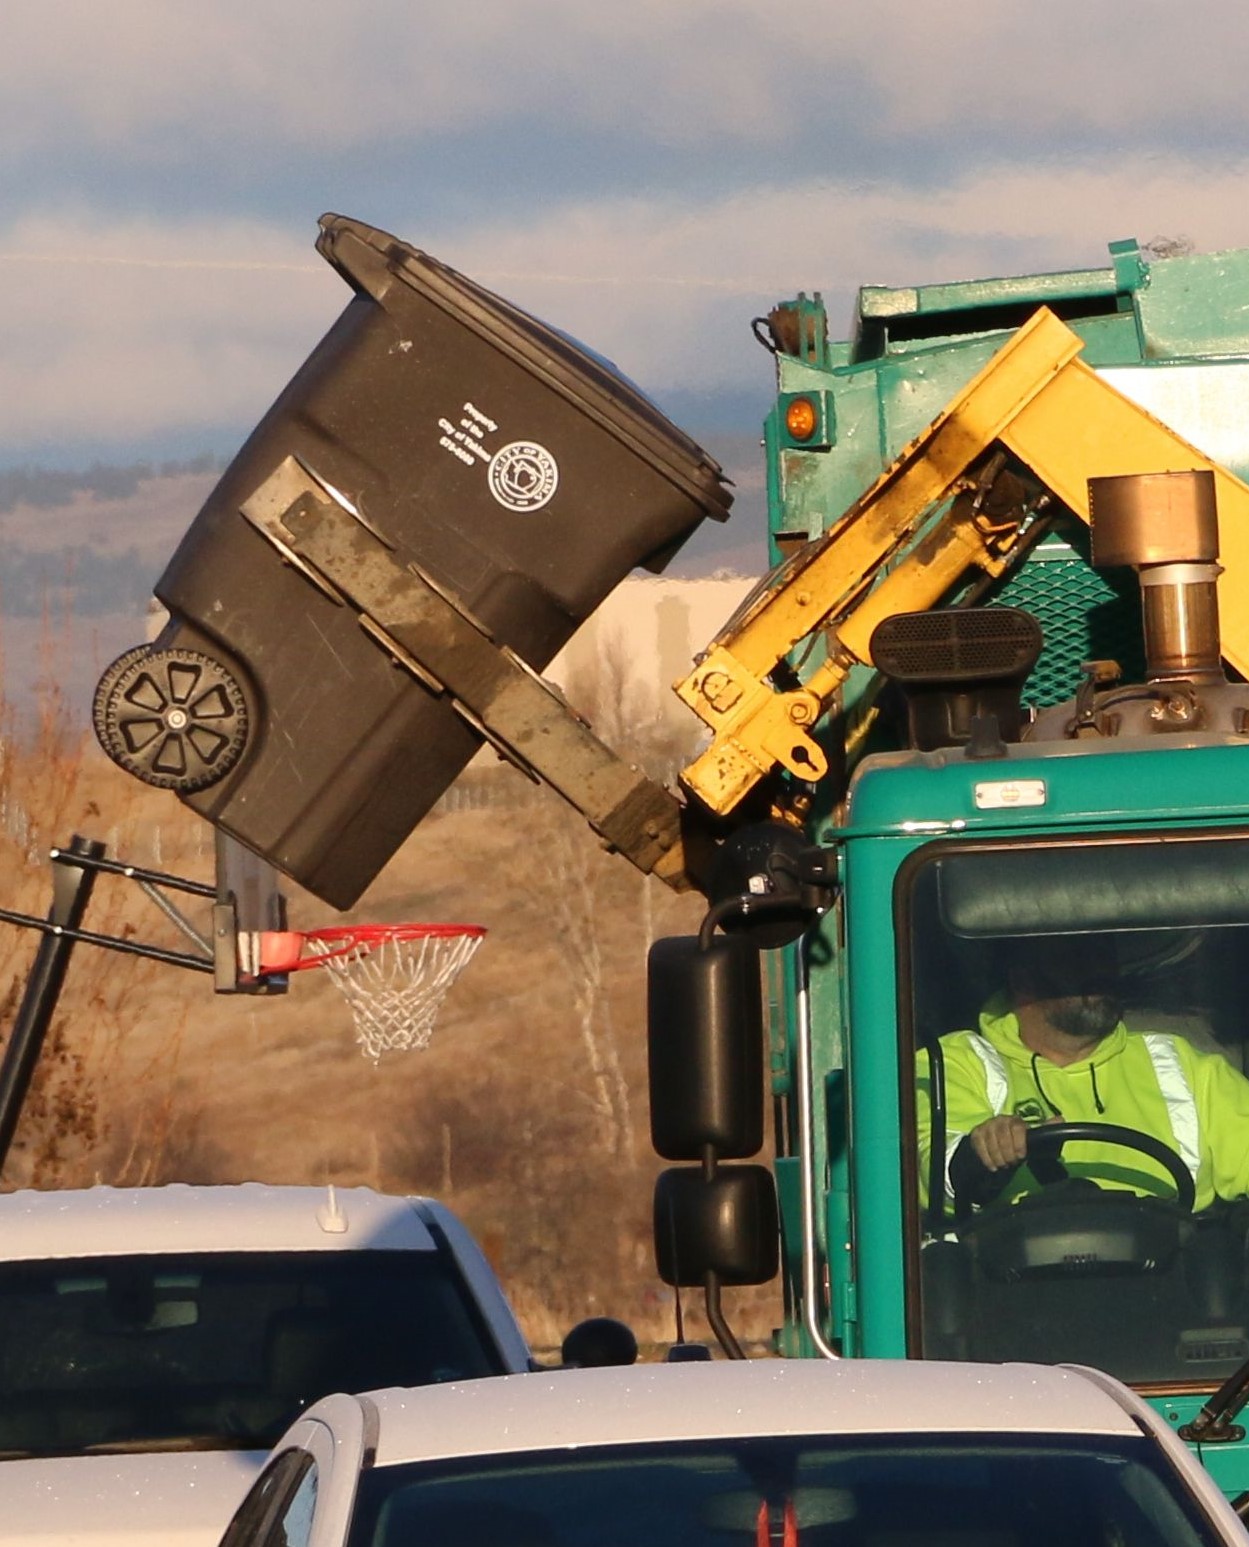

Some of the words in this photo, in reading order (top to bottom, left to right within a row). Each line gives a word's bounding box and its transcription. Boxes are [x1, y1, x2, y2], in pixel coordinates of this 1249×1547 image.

[460, 418, 473, 429] of
[469, 424, 484, 439] the
[463, 402, 498, 432] Property
[438, 418, 456, 435] City
[454, 431, 466, 442] of
[463, 436, 492, 462] Yakima
[495, 447, 521, 471] CITY
[533, 451, 553, 501] YAKIMA
